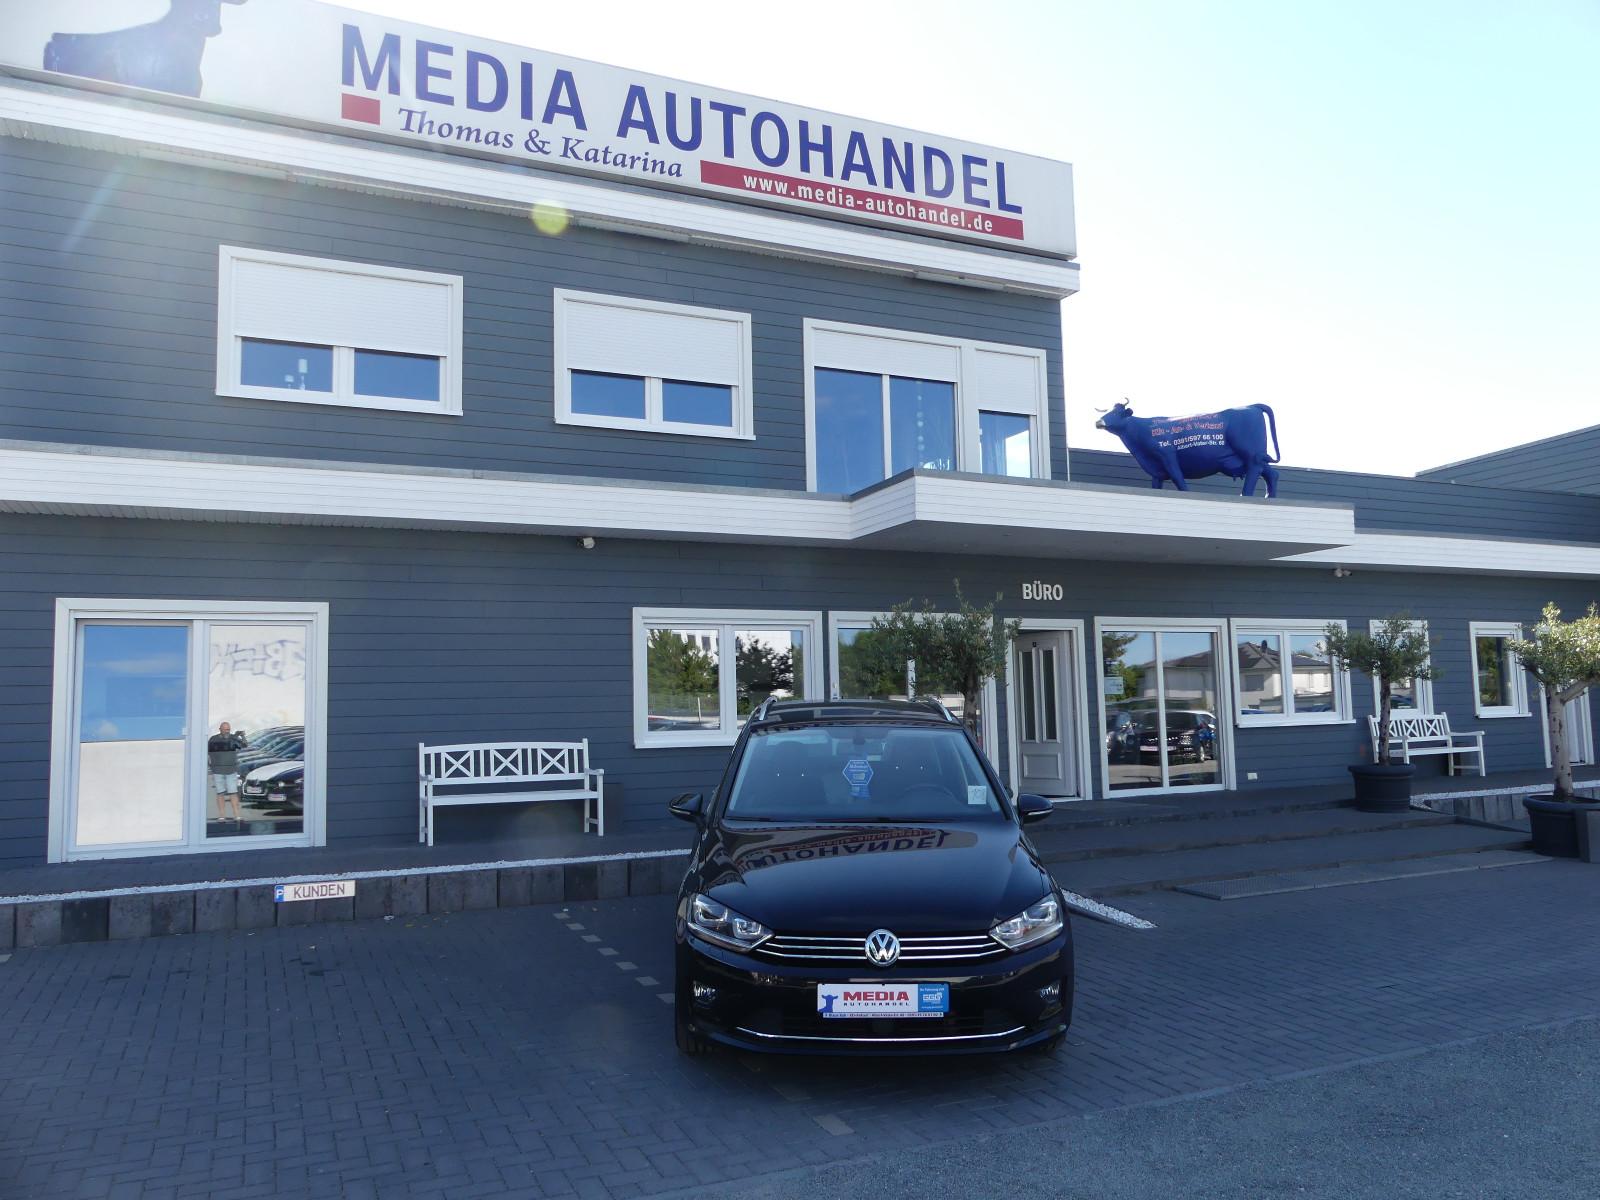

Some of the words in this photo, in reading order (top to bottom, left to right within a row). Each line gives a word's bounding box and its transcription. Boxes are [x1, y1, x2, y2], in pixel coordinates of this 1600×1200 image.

[341, 23, 588, 131] MEDIA
[616, 84, 1022, 215] AUTOHANDEL
[398, 107, 514, 149] Thomas
[524, 129, 551, 156] &
[559, 136, 683, 178] Katarina
[743, 174, 993, 233] www.media-autohandel.de
[1022, 580, 1063, 600] BÜRO
[276, 889, 284, 899] P
[294, 883, 345, 899] KUNDEN
[843, 991, 910, 1001] MEDIA
